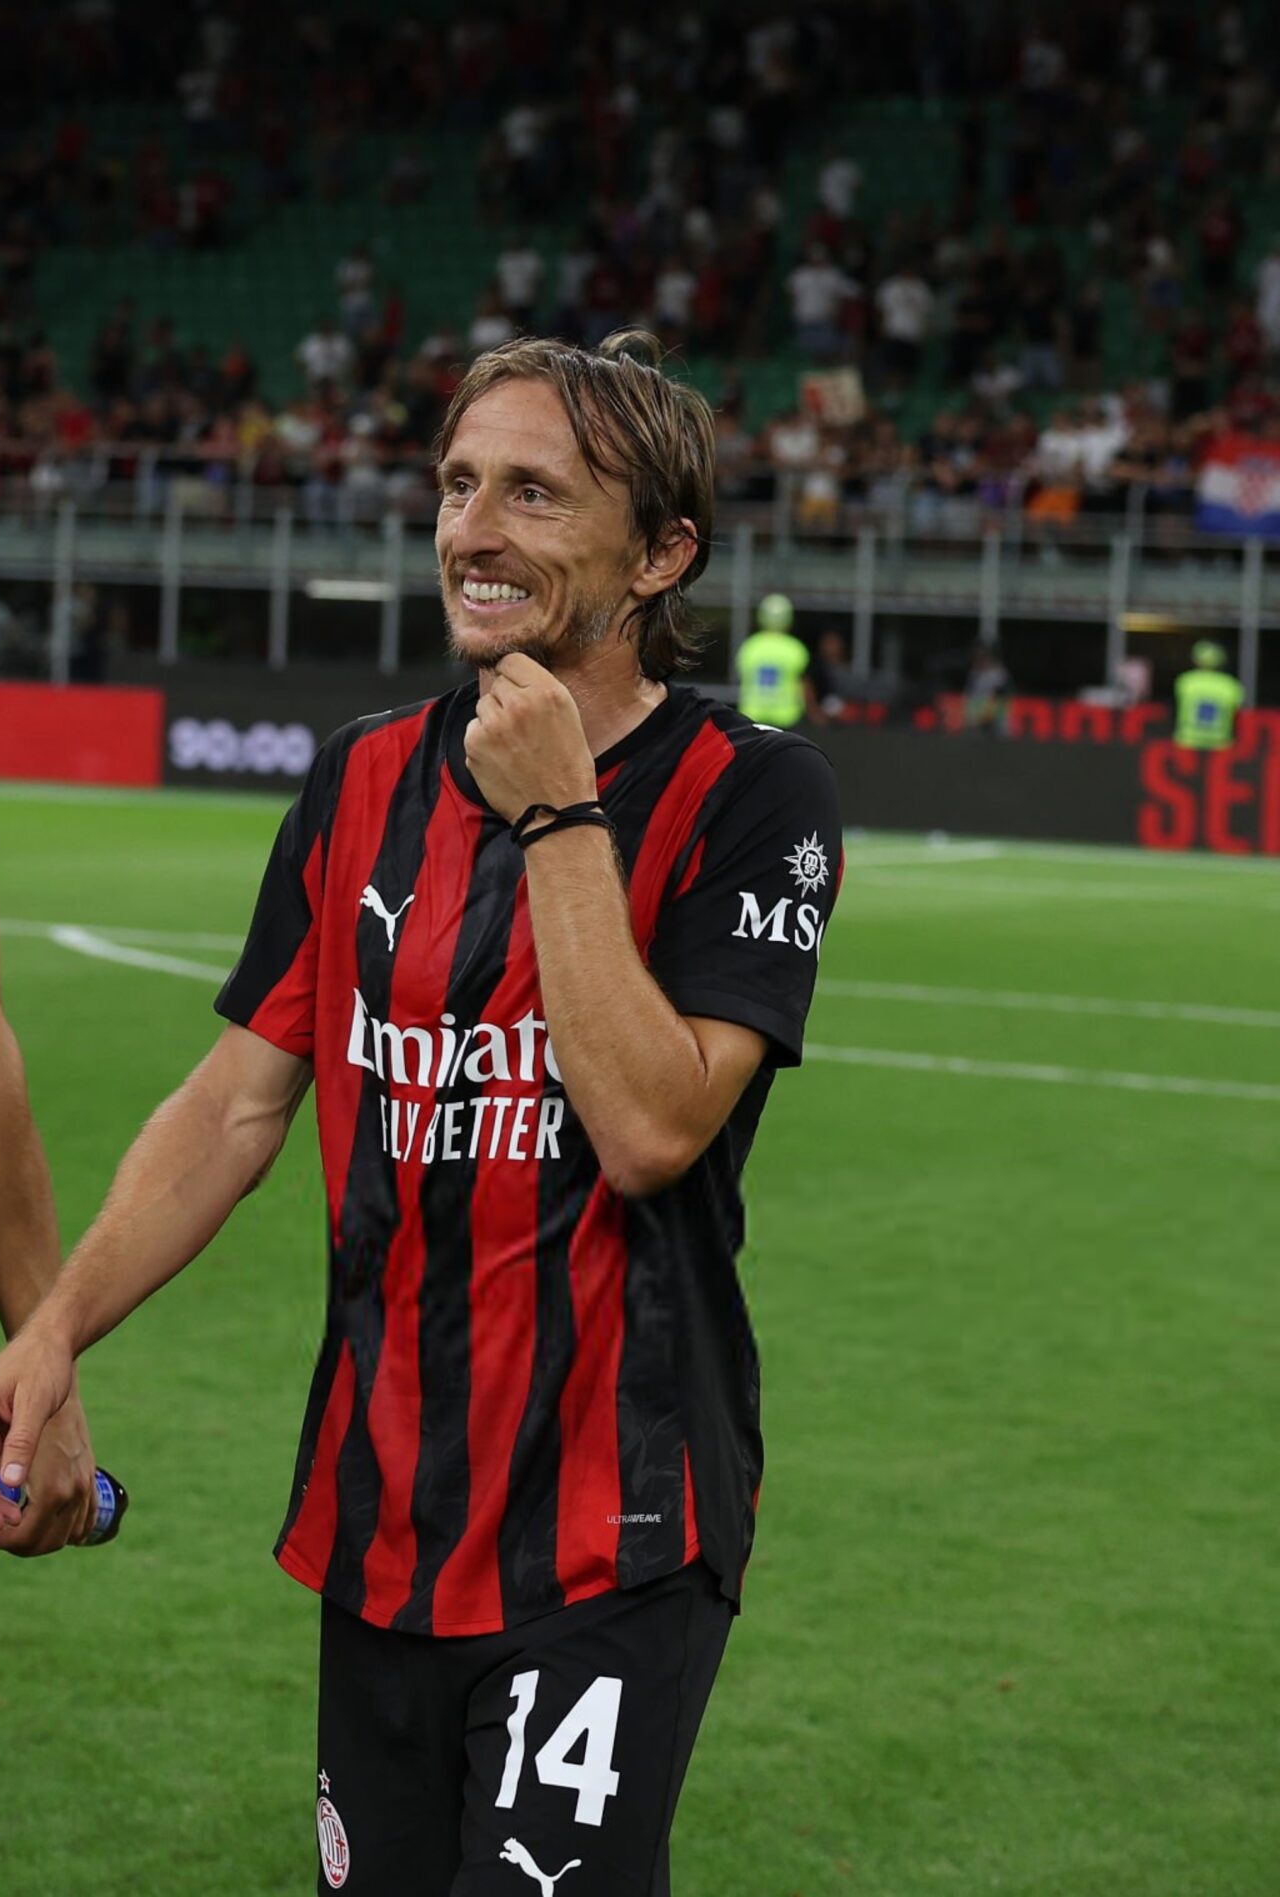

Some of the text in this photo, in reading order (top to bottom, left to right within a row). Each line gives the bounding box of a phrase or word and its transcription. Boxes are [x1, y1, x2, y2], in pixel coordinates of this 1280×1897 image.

[169, 716, 316, 776] 90:00
[731, 891, 825, 961] MS
[421, 1097, 565, 1165] BETTER
[606, 1512, 662, 1525] ULTRAWEAVE
[494, 1669, 623, 1827] 14
